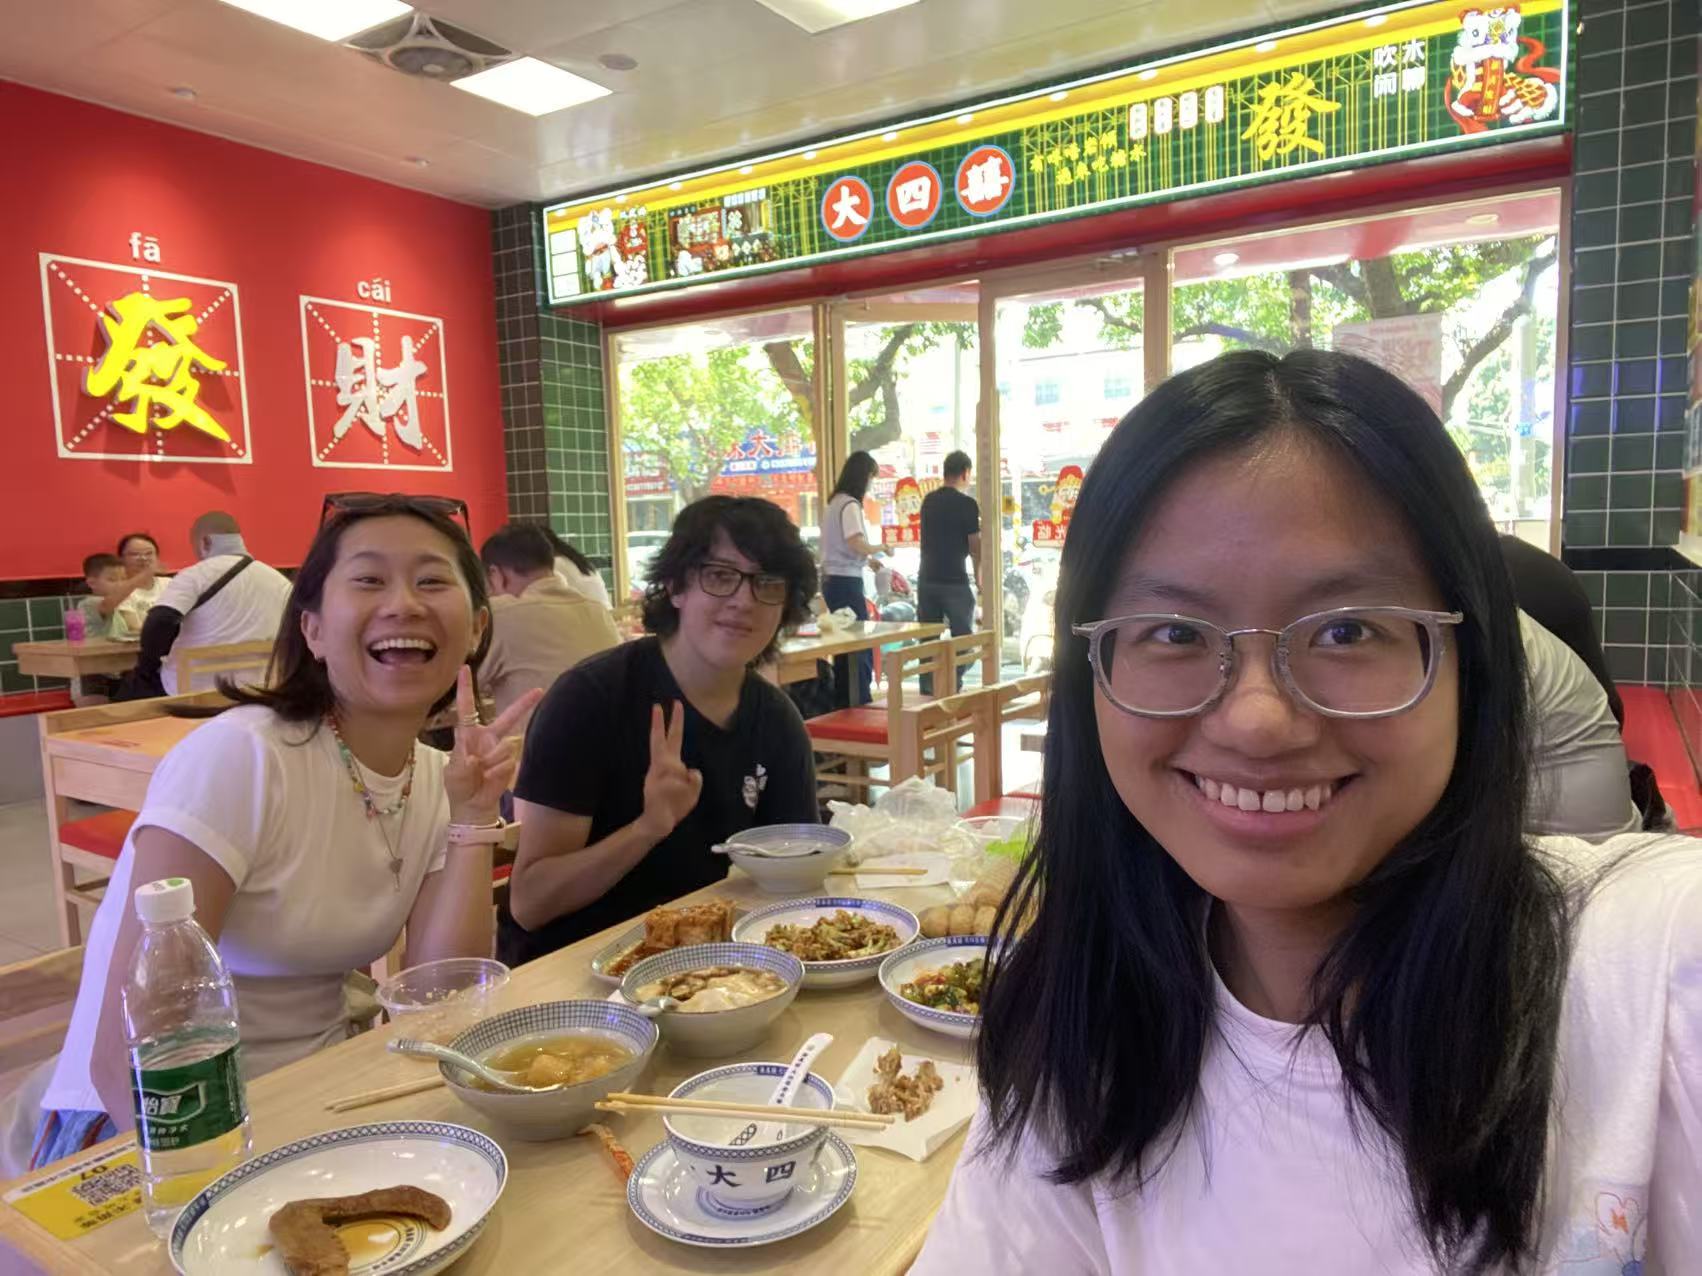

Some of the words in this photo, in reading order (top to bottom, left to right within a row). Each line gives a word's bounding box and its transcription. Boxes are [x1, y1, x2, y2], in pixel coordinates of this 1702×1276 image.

[1241, 71, 1341, 161] 發
[129, 231, 161, 264] fā
[357, 279, 391, 304] cái
[84, 292, 231, 441] 發
[333, 335, 428, 452] 財
